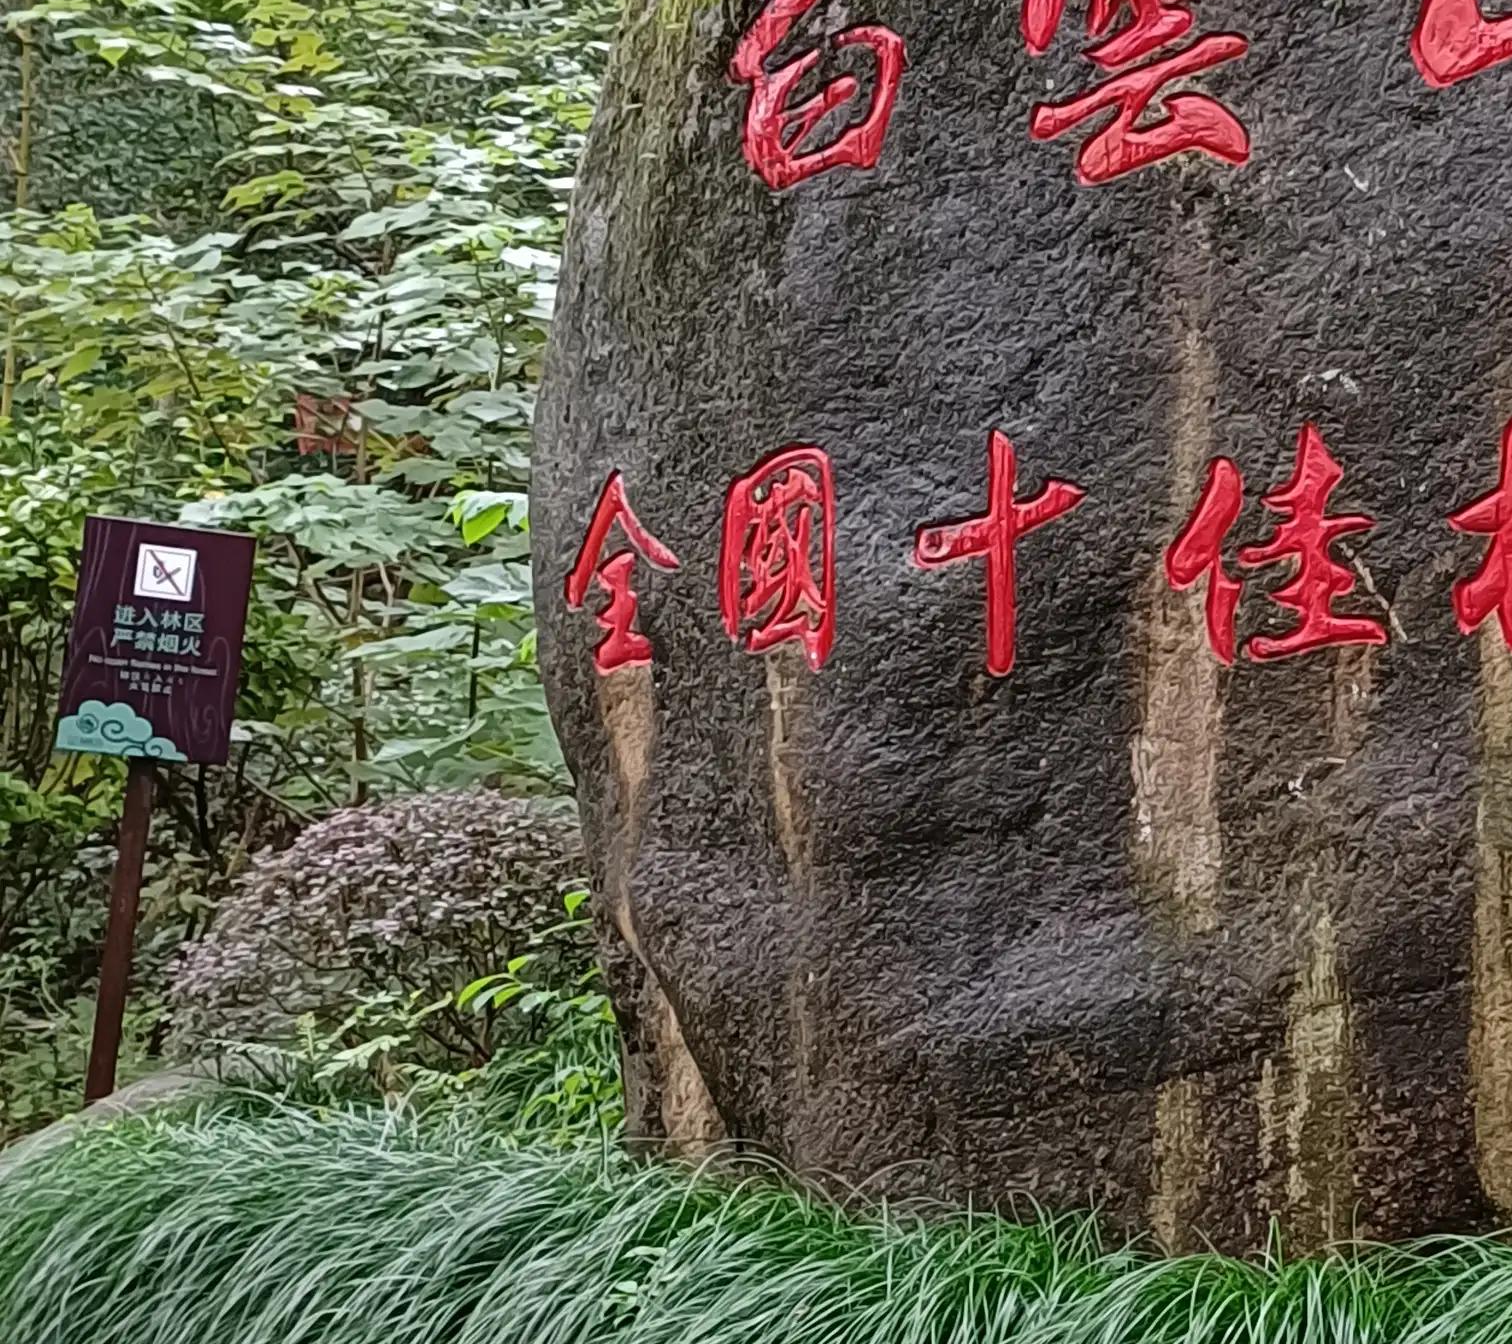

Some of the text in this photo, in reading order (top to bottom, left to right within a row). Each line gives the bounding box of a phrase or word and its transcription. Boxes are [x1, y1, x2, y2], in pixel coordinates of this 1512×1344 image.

[114, 604, 205, 632] 进入林区
[110, 628, 202, 656] 严禁烟火
